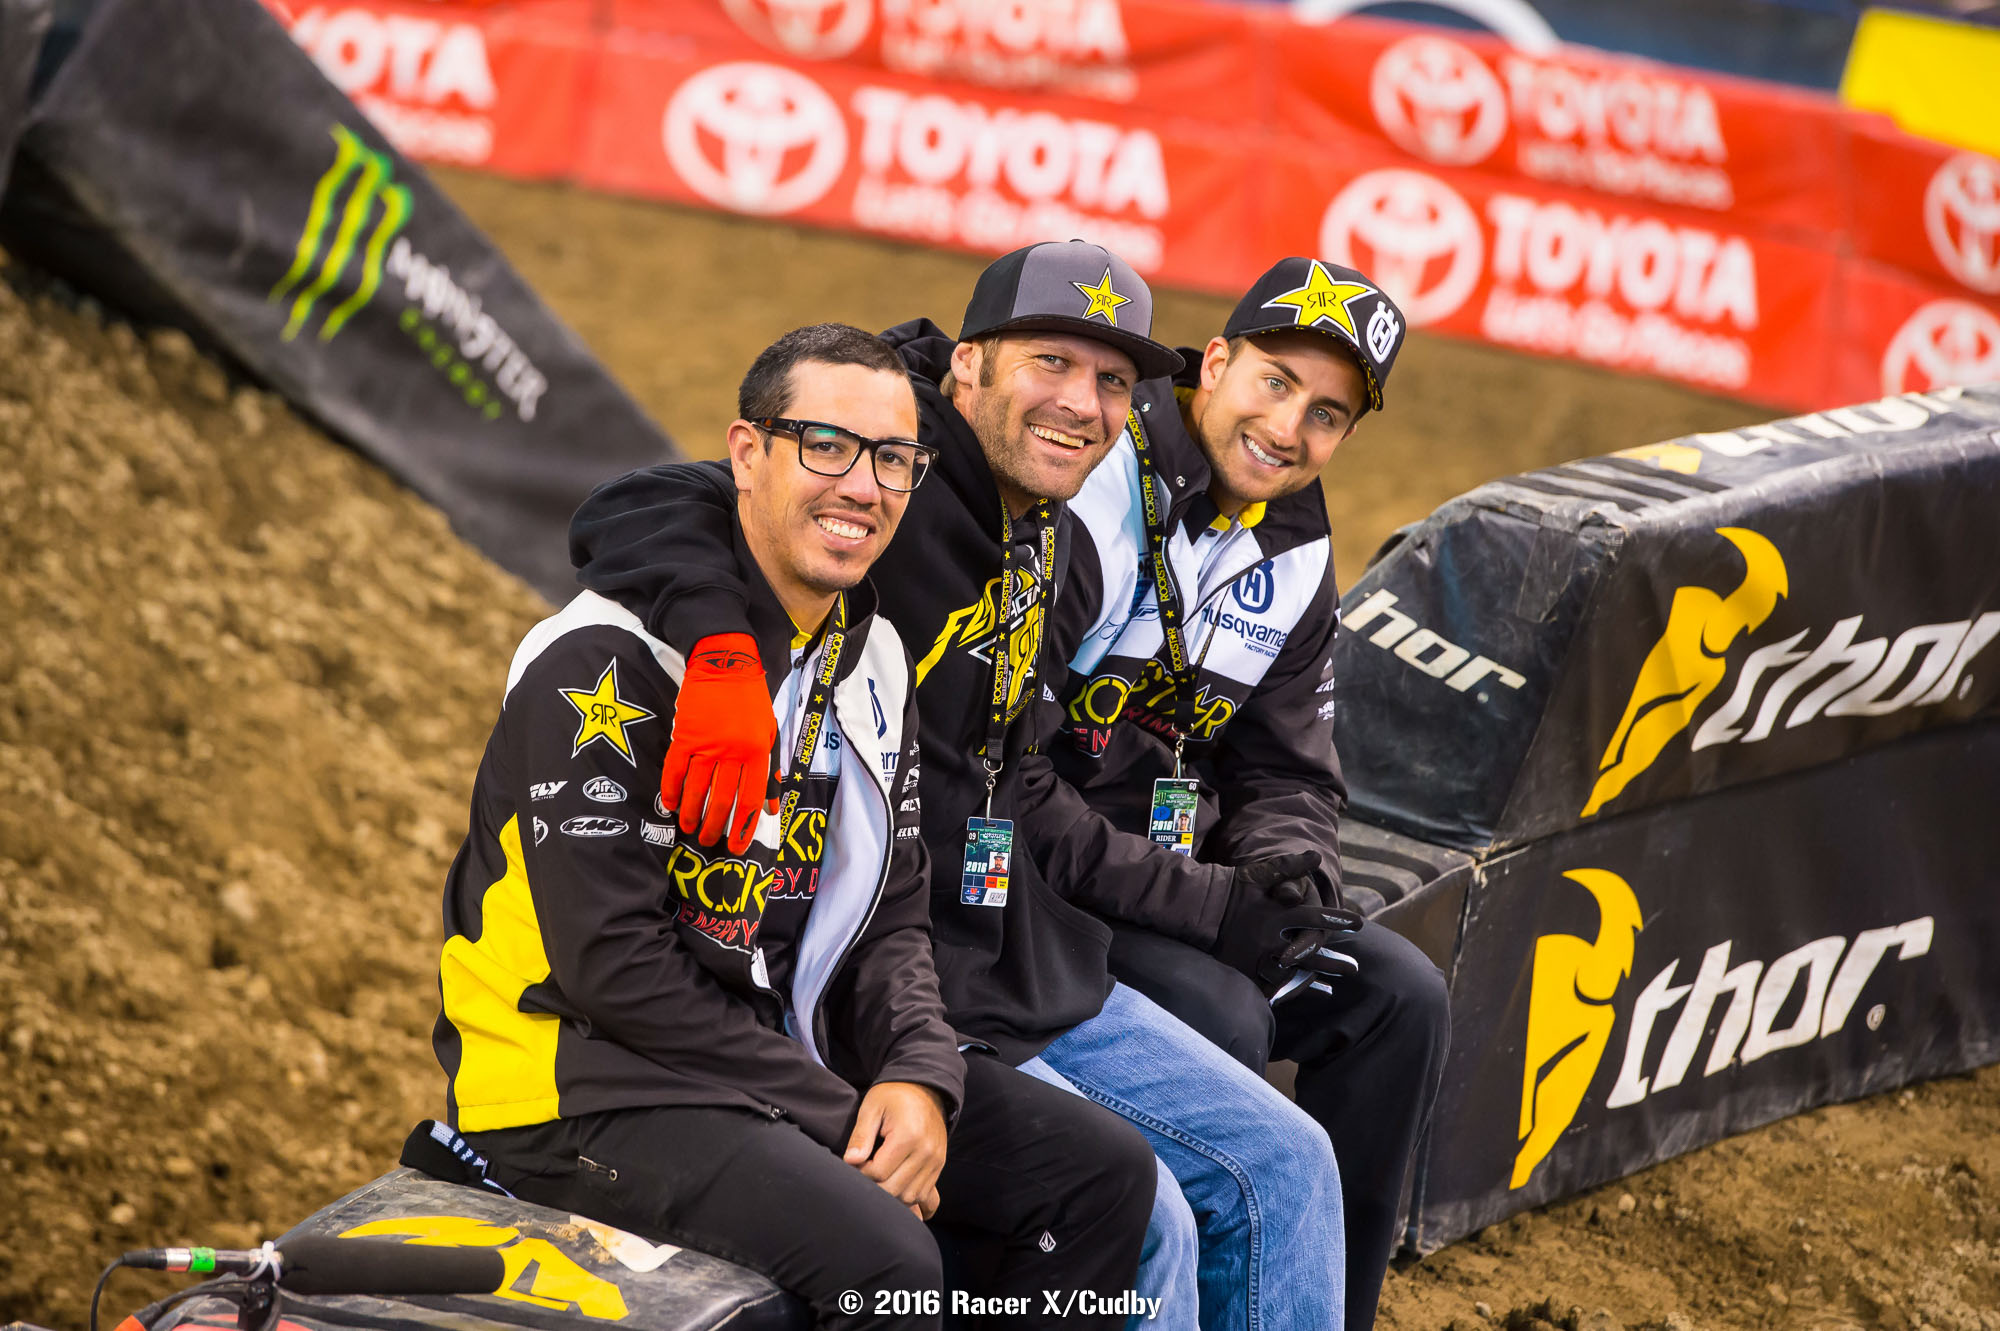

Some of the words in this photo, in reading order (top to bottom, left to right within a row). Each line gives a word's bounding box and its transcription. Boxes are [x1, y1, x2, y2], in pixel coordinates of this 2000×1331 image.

[851, 86, 1169, 219] TOYOTA
[1502, 57, 1728, 163] TOYOTA
[1486, 193, 1759, 329] TOYOTA
[1341, 588, 1527, 692] hor
[1691, 611, 2000, 751] thor
[530, 781, 568, 798] FLY
[968, 832, 977, 841] 09
[1152, 821, 1173, 831] 2016
[965, 861, 988, 873] 2016
[1606, 916, 1934, 1109] thor
